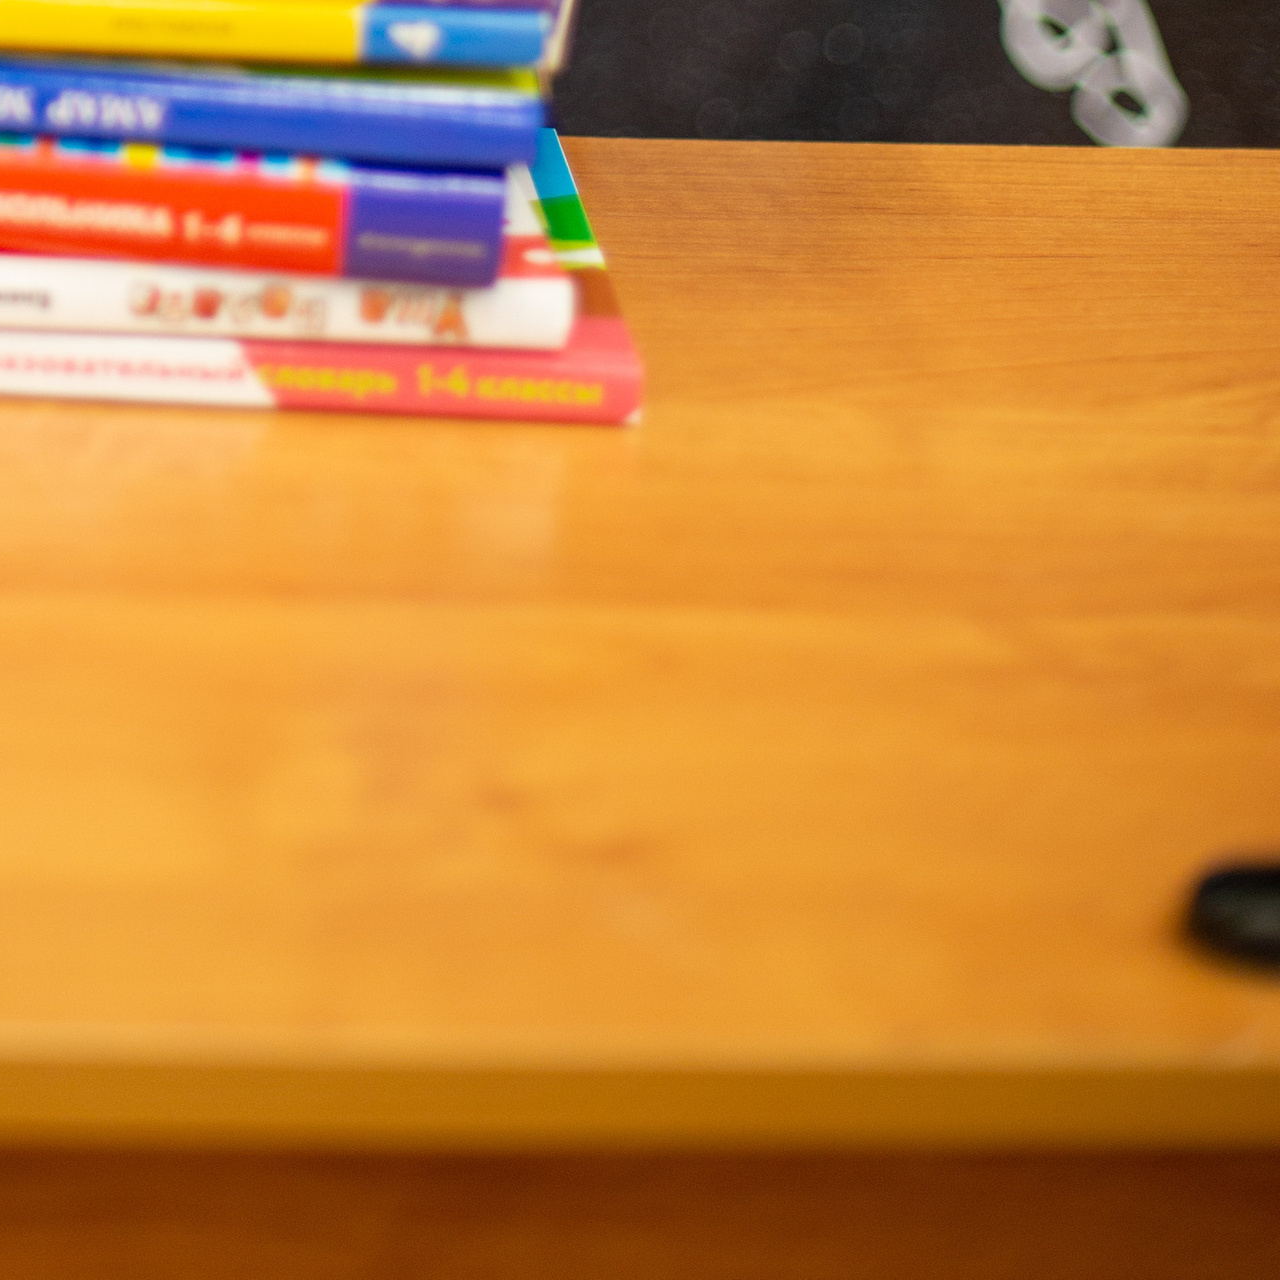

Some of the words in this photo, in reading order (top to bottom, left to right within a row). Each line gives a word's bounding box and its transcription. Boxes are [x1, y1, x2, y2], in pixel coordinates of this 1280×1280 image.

[44, 90, 166, 130] АМАР
[255, 361, 398, 399] словарь
[476, 373, 606, 406] классы
